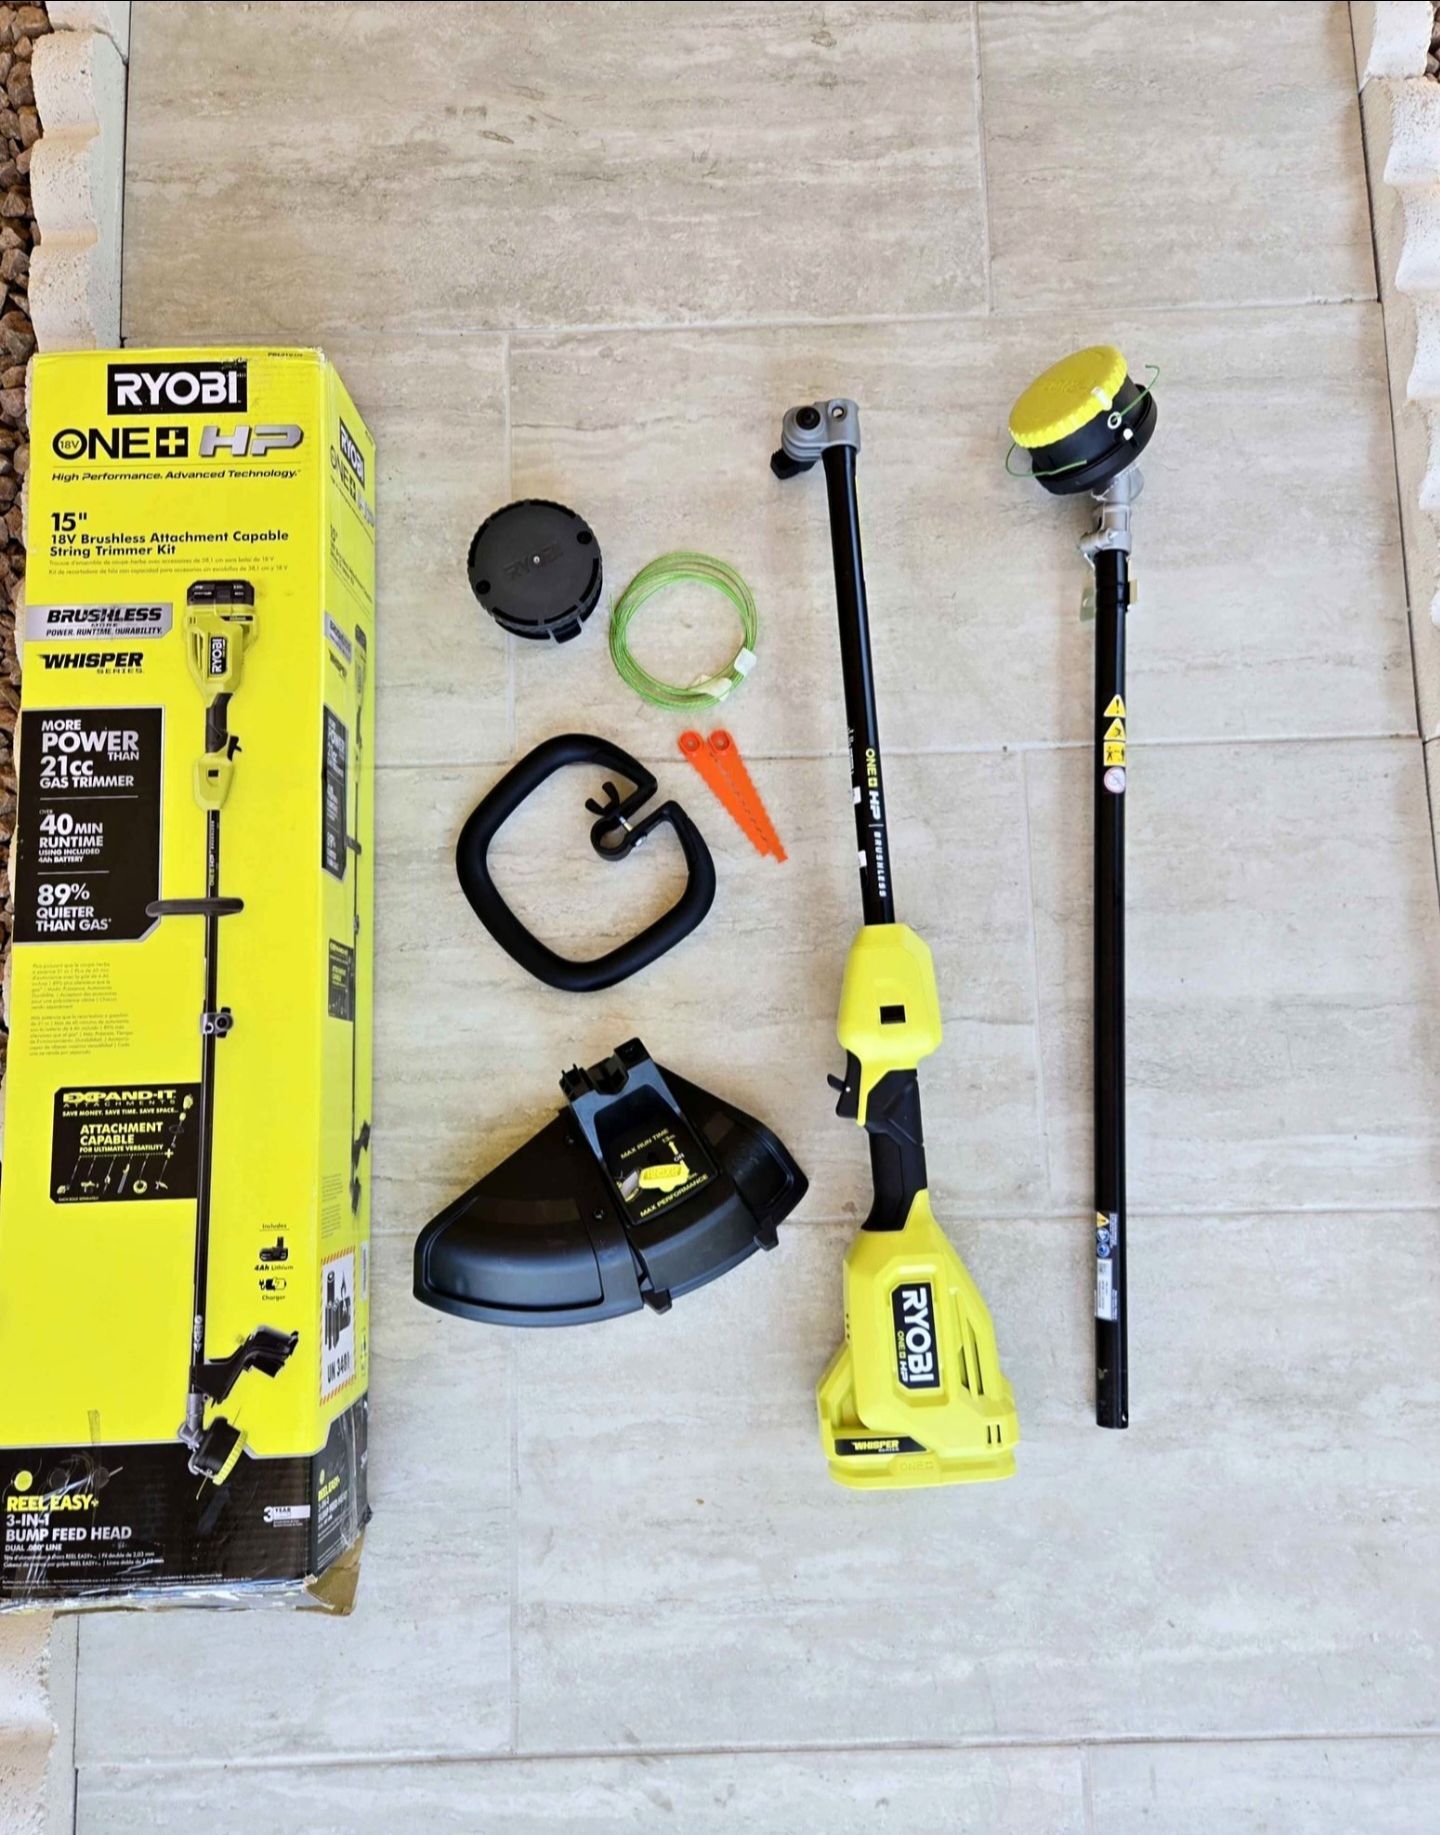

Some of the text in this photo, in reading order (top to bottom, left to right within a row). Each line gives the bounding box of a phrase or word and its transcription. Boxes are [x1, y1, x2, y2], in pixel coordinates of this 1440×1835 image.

[114, 370, 239, 407] RYOBI
[59, 438, 79, 450] 18V
[199, 424, 304, 458] HP
[51, 472, 79, 482] High
[82, 471, 162, 481] Performance.
[165, 470, 225, 479] Advanced
[50, 511, 88, 532] 15"
[52, 530, 289, 545] 18V Brushless Attachment Capable
[50, 544, 176, 559] String Trimmer Kit
[47, 607, 163, 623] BRUSHLESS
[38, 651, 144, 670] WHISPER
[211, 639, 222, 674] RYOBI
[41, 719, 82, 731] MORE
[42, 730, 139, 753] POWER
[107, 751, 139, 761] THAN
[40, 755, 94, 777] 21cc
[39, 775, 134, 789] GAS TRIMMER
[868, 790, 881, 821] HP
[40, 812, 103, 835] 40 MIN
[39, 836, 103, 848] RUNTIME
[874, 831, 887, 898] BRUSHLESS
[37, 882, 90, 906] 89%
[36, 905, 94, 920] QUIETER
[36, 919, 75, 932] THAN
[80, 1122, 163, 1135] ATTACHMENT
[80, 1134, 135, 1146] CAPABLE
[621, 1128, 669, 1160] MAX RUN TIME
[93, 1145, 125, 1153] ULTIMATE
[640, 1204, 657, 1218] MAX
[656, 1173, 709, 1208] PERFORMANCE
[262, 1294, 286, 1302] Charger
[902, 1287, 935, 1383] RYOBI
[851, 1439, 900, 1451] WHISPER
[7, 1494, 99, 1512] REEL EASY+
[6, 1513, 50, 1527] 3-IN-1
[263, 1506, 274, 1523] 3
[6, 1526, 132, 1542] BUMP FEED HEAD
[5, 1543, 25, 1551] DUAL
[45, 1542, 63, 1551] LINE
